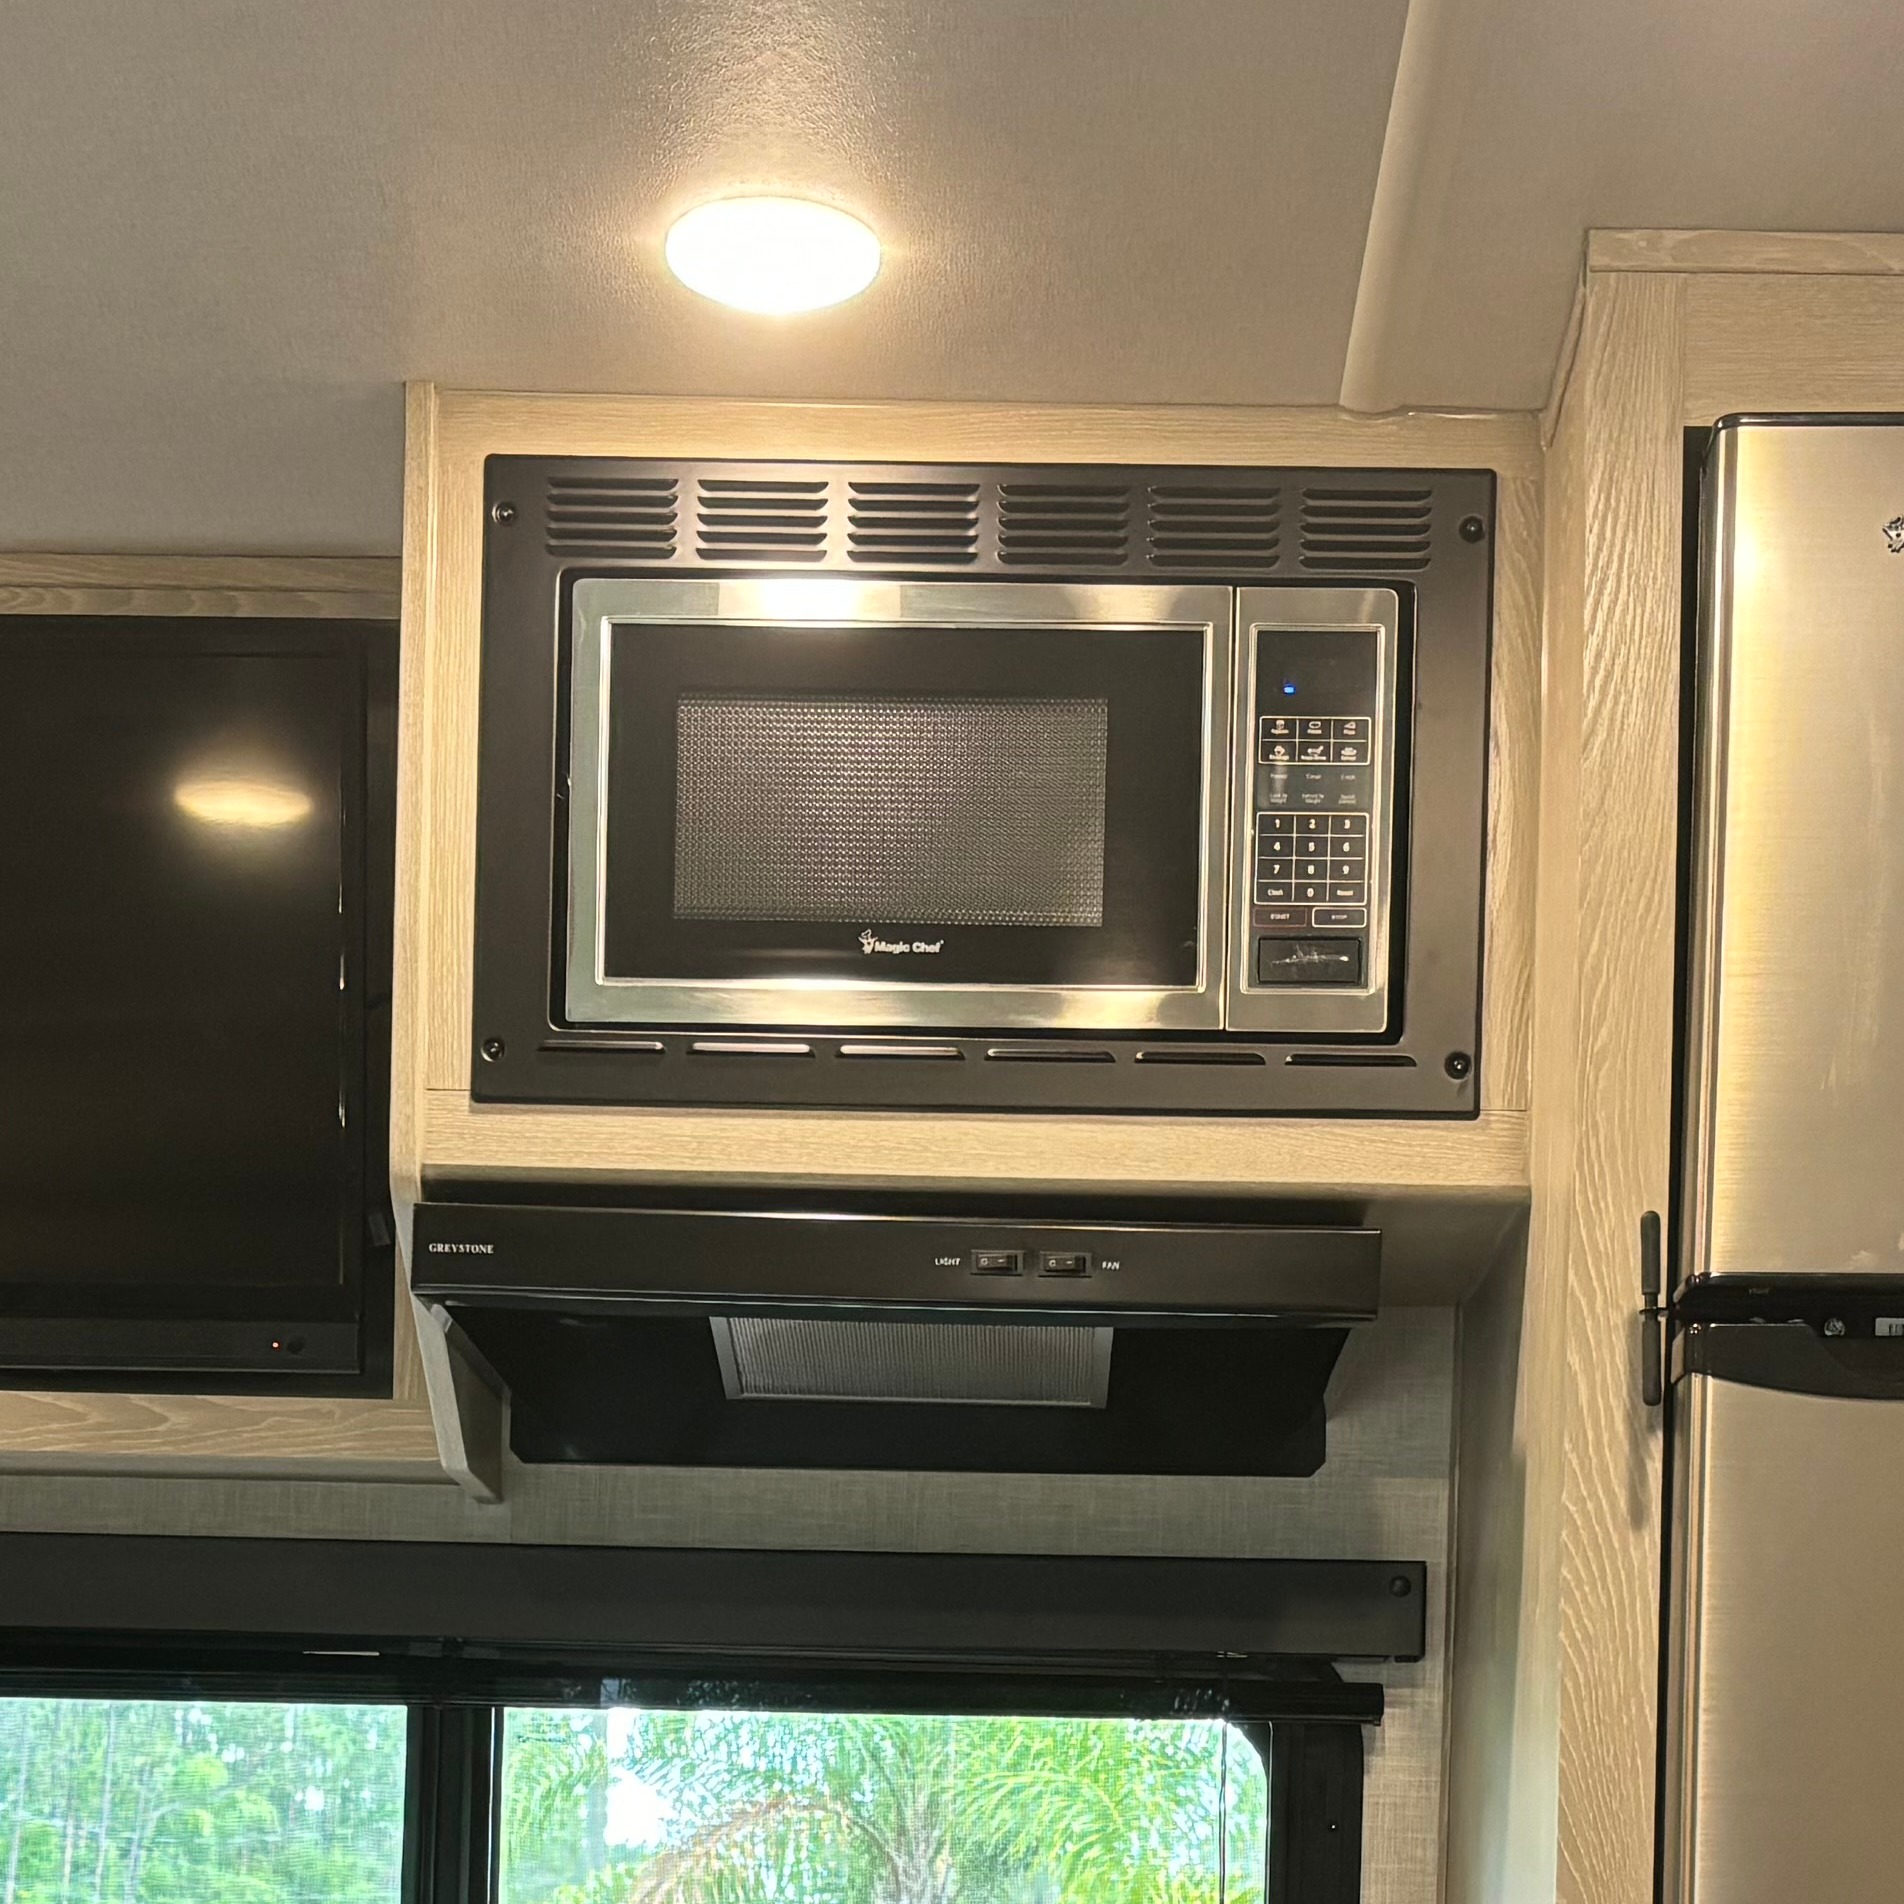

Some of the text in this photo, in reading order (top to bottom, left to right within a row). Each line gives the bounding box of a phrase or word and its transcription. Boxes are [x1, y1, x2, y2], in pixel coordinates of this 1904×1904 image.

[874, 941, 940, 954] Magic Chef
[428, 1243, 494, 1254] GREYSTONE
[935, 1257, 961, 1266] LIGHT
[1102, 1261, 1120, 1270] FAN
